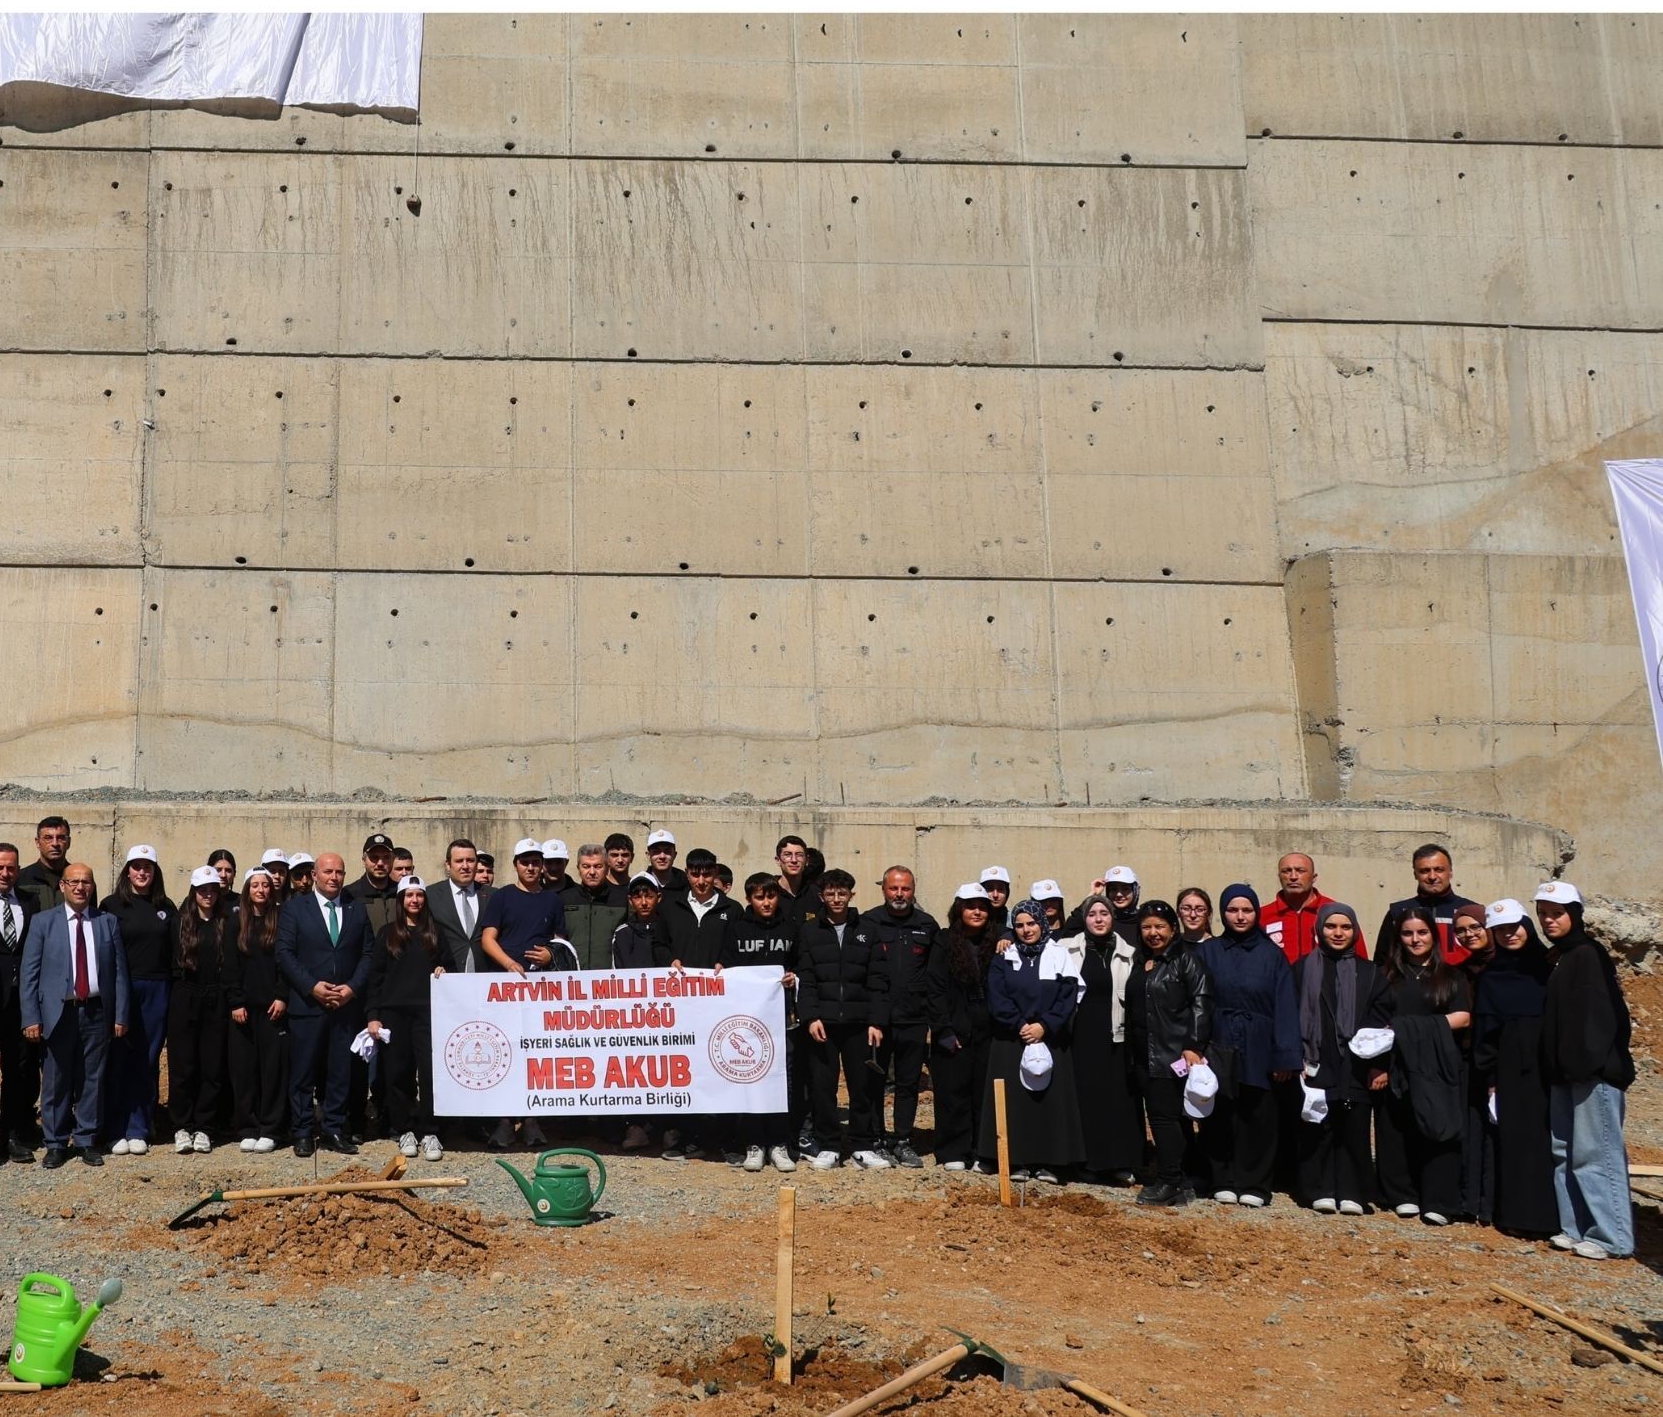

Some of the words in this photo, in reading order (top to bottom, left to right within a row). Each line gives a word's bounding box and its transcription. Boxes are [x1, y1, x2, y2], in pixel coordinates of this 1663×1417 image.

[487, 976, 562, 1002] ARTVİN
[568, 975, 587, 1001] İL
[591, 973, 648, 1000] MİLLİ
[653, 971, 725, 997] EĞİTİM
[543, 1002, 675, 1031] MÜDÜRLÜĞÜ
[555, 1034, 590, 1049] SAĞLIK
[594, 1036, 607, 1048] VE
[609, 1032, 659, 1047] GÜVENLİK
[662, 1031, 696, 1046] BİRİMİ
[527, 1057, 596, 1090] MEB
[603, 1055, 692, 1089] AKUB
[527, 1093, 576, 1110] (Arama
[579, 1092, 641, 1107] Kurtarma
[647, 1092, 691, 1108] Birliği)
